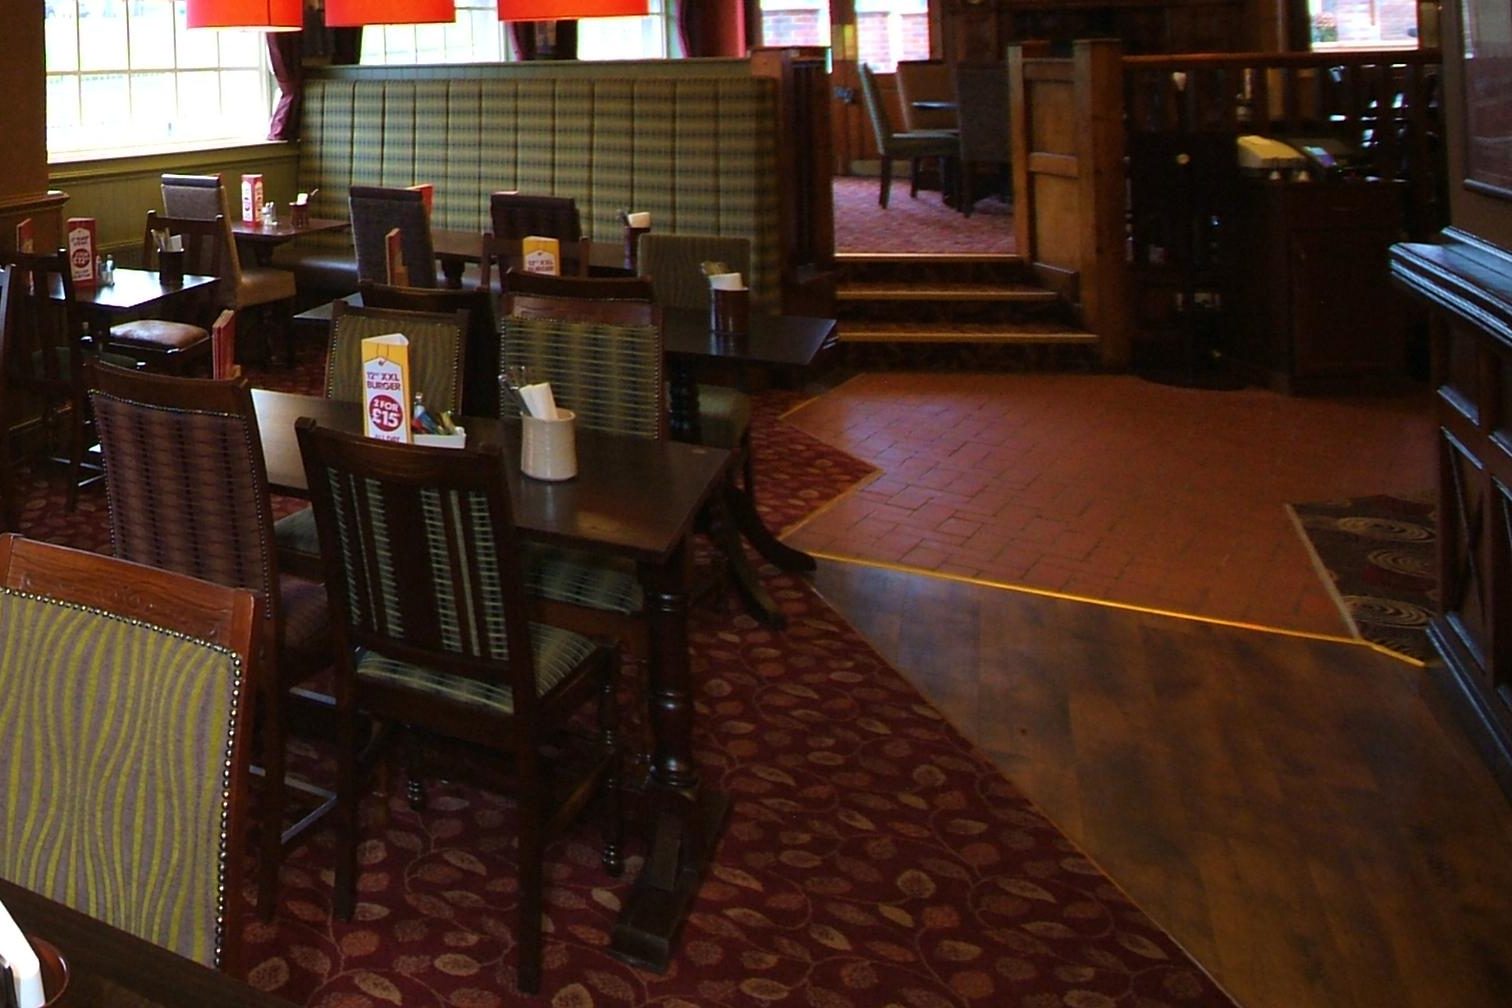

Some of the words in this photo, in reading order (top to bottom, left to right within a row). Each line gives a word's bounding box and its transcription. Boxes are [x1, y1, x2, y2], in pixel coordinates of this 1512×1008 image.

[381, 373, 400, 382] XXL
[367, 380, 401, 391] BURGER
[379, 400, 399, 412] FOR
[372, 408, 400, 429] £15
